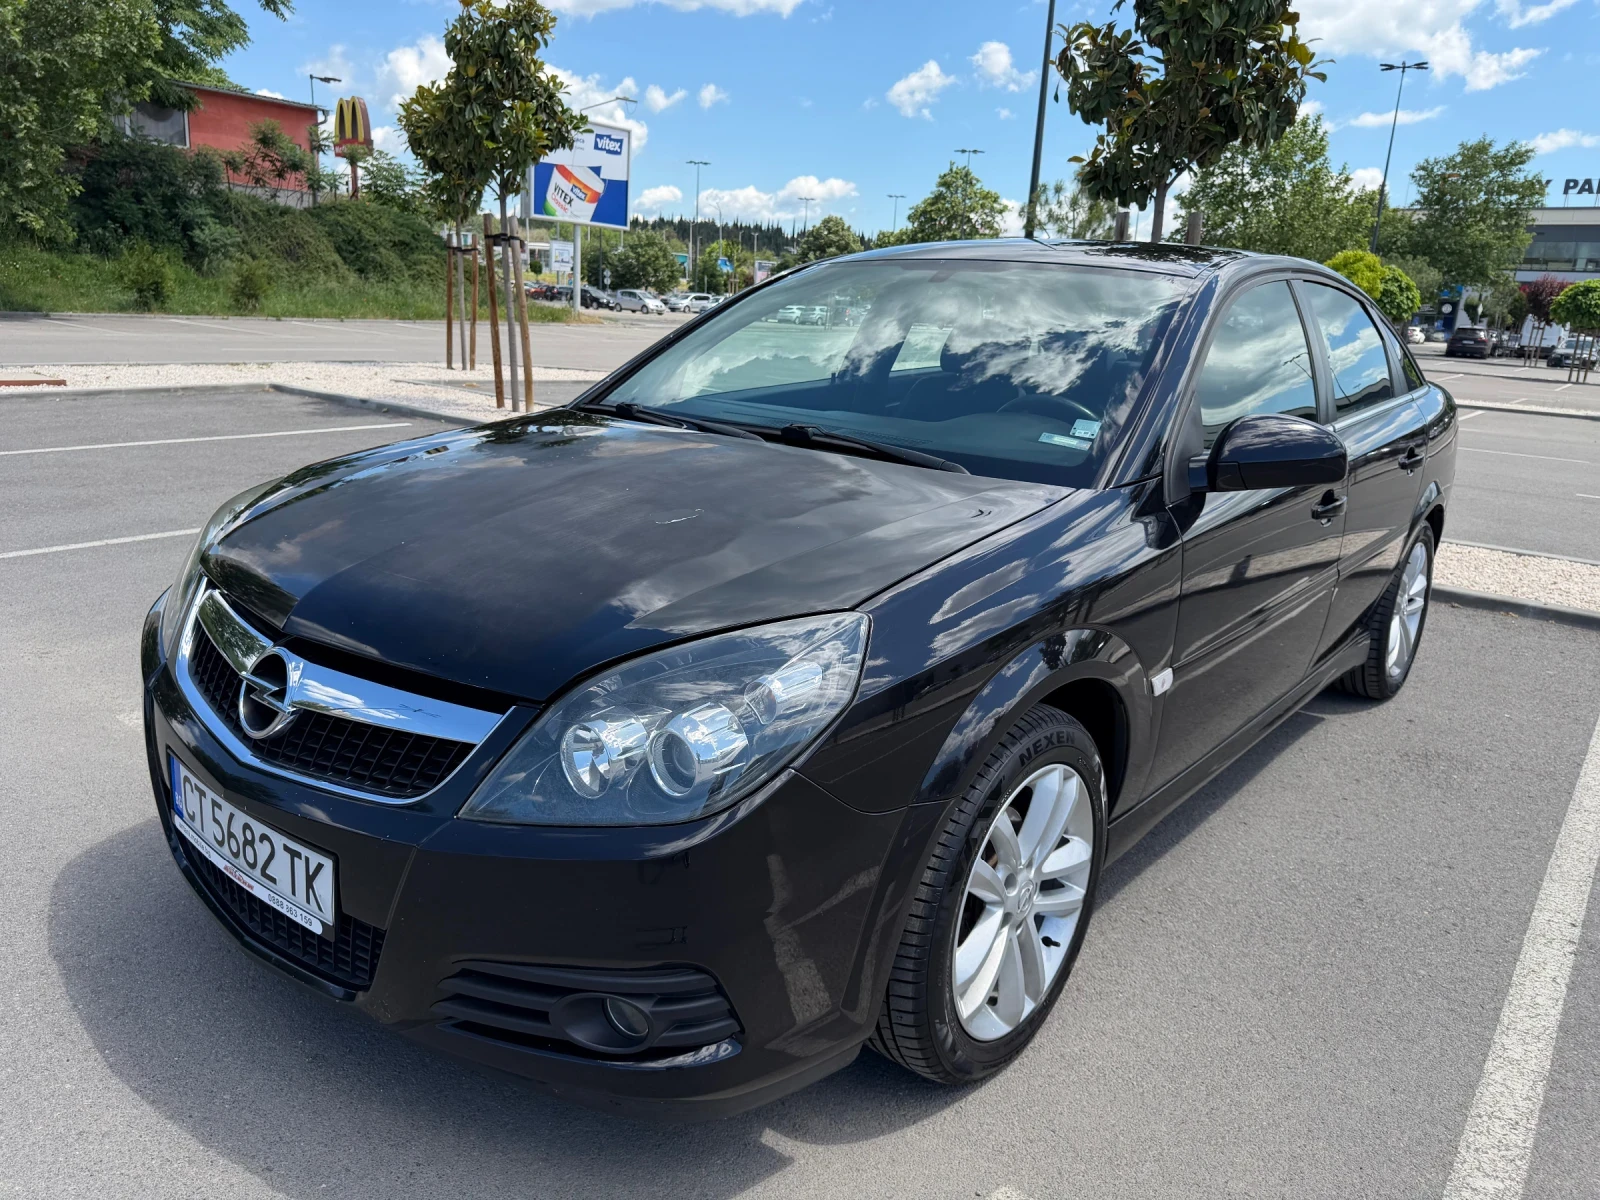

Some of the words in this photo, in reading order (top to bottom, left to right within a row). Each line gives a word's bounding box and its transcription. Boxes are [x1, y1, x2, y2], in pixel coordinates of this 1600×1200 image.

[596, 137, 621, 152] vitex
[554, 182, 574, 207] VITEX
[1563, 178, 1600, 195] PA
[1018, 729, 1076, 768] NEXEN
[267, 893, 285, 910] 0888
[299, 913, 313, 927] 159
